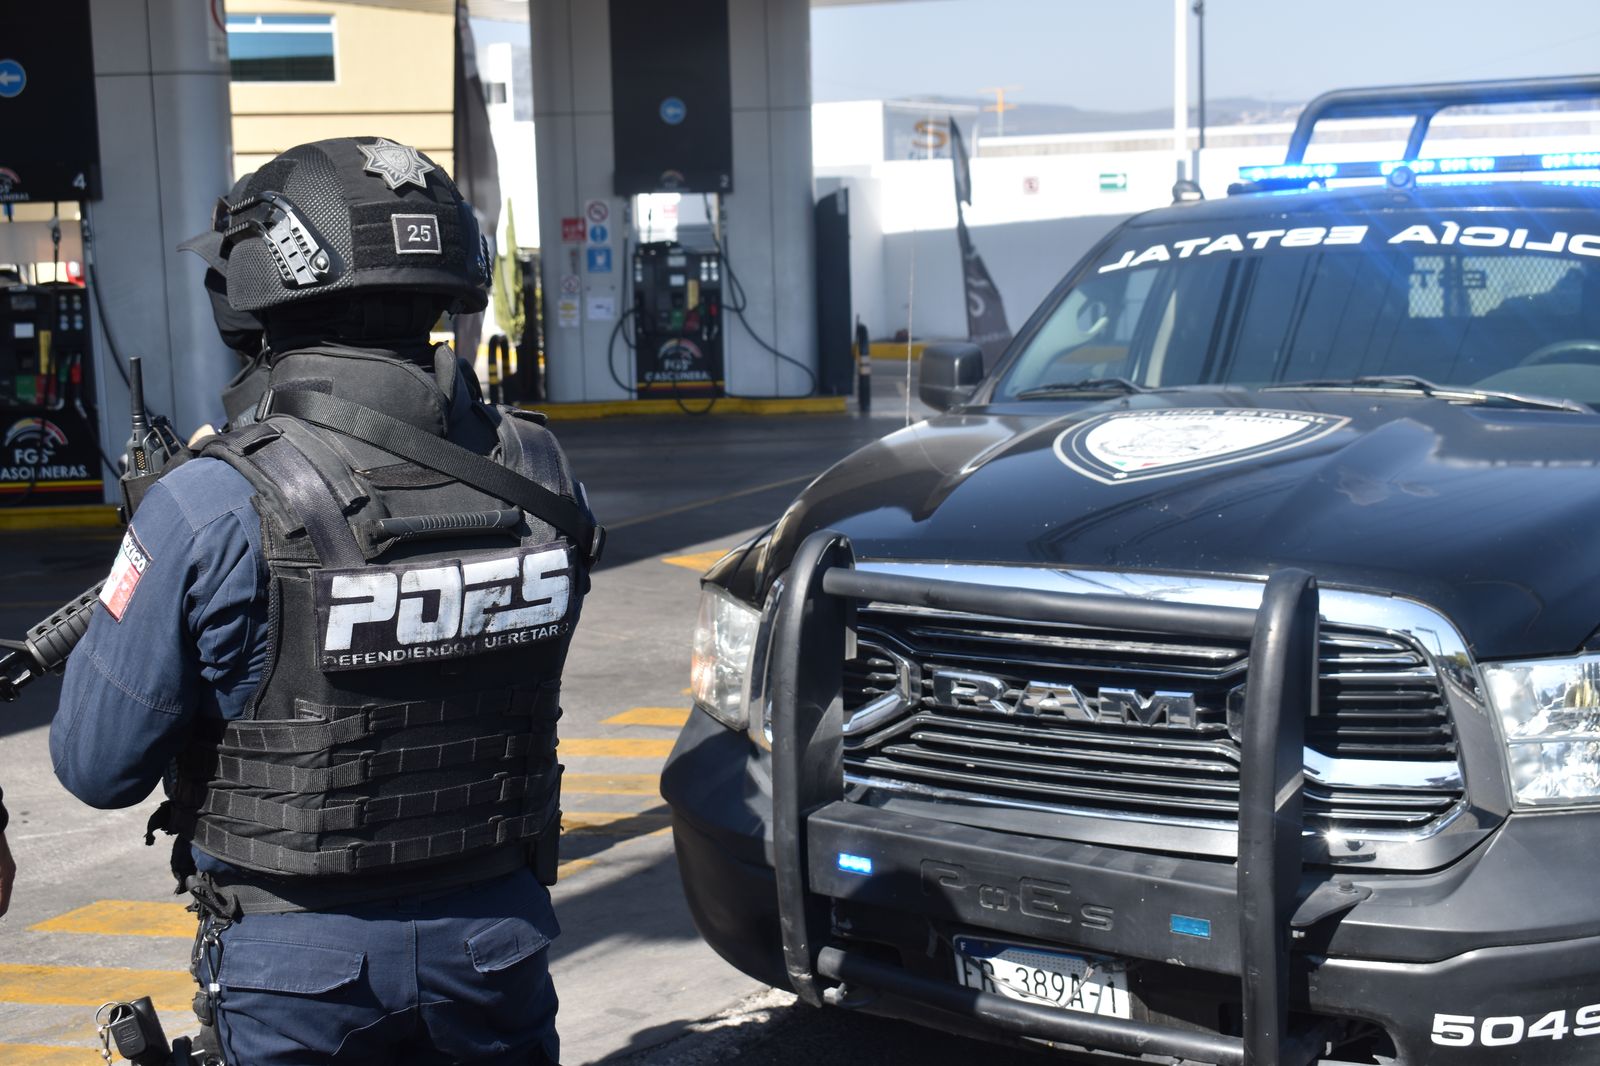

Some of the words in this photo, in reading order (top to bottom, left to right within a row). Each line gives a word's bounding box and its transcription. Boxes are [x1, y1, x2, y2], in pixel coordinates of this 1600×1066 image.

[73, 172, 87, 190] 4
[407, 225, 431, 242] 25
[933, 671, 1197, 730] RAM
